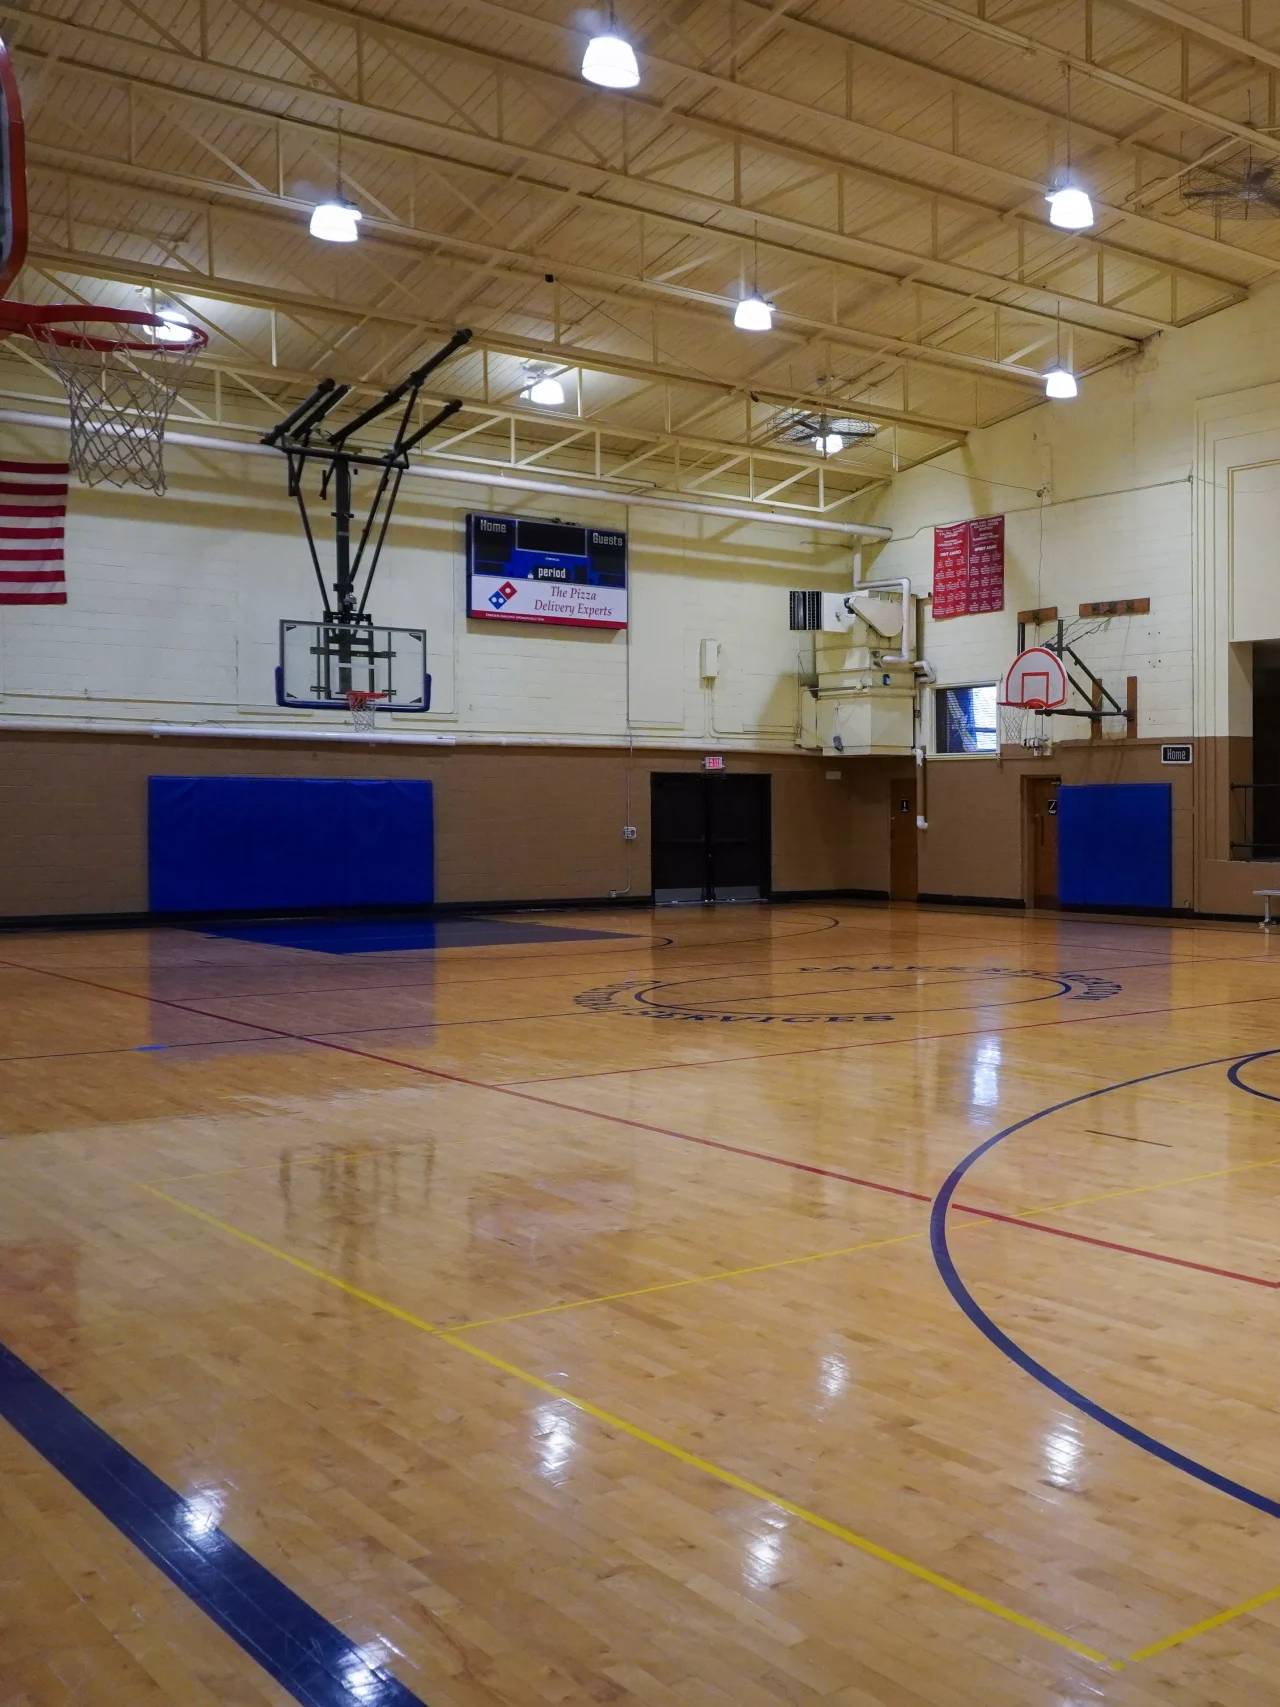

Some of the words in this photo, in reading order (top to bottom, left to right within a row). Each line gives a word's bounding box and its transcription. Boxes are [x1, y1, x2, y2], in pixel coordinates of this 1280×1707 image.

[480, 519, 507, 534] Home
[592, 532, 623, 547] Guests
[538, 567, 566, 580] period
[550, 585, 568, 598] The
[570, 588, 597, 601] Pizza
[534, 599, 576, 616] Delivery
[577, 603, 613, 618] Experts
[1167, 749, 1186, 760] Home
[708, 757, 720, 768] EXIT
